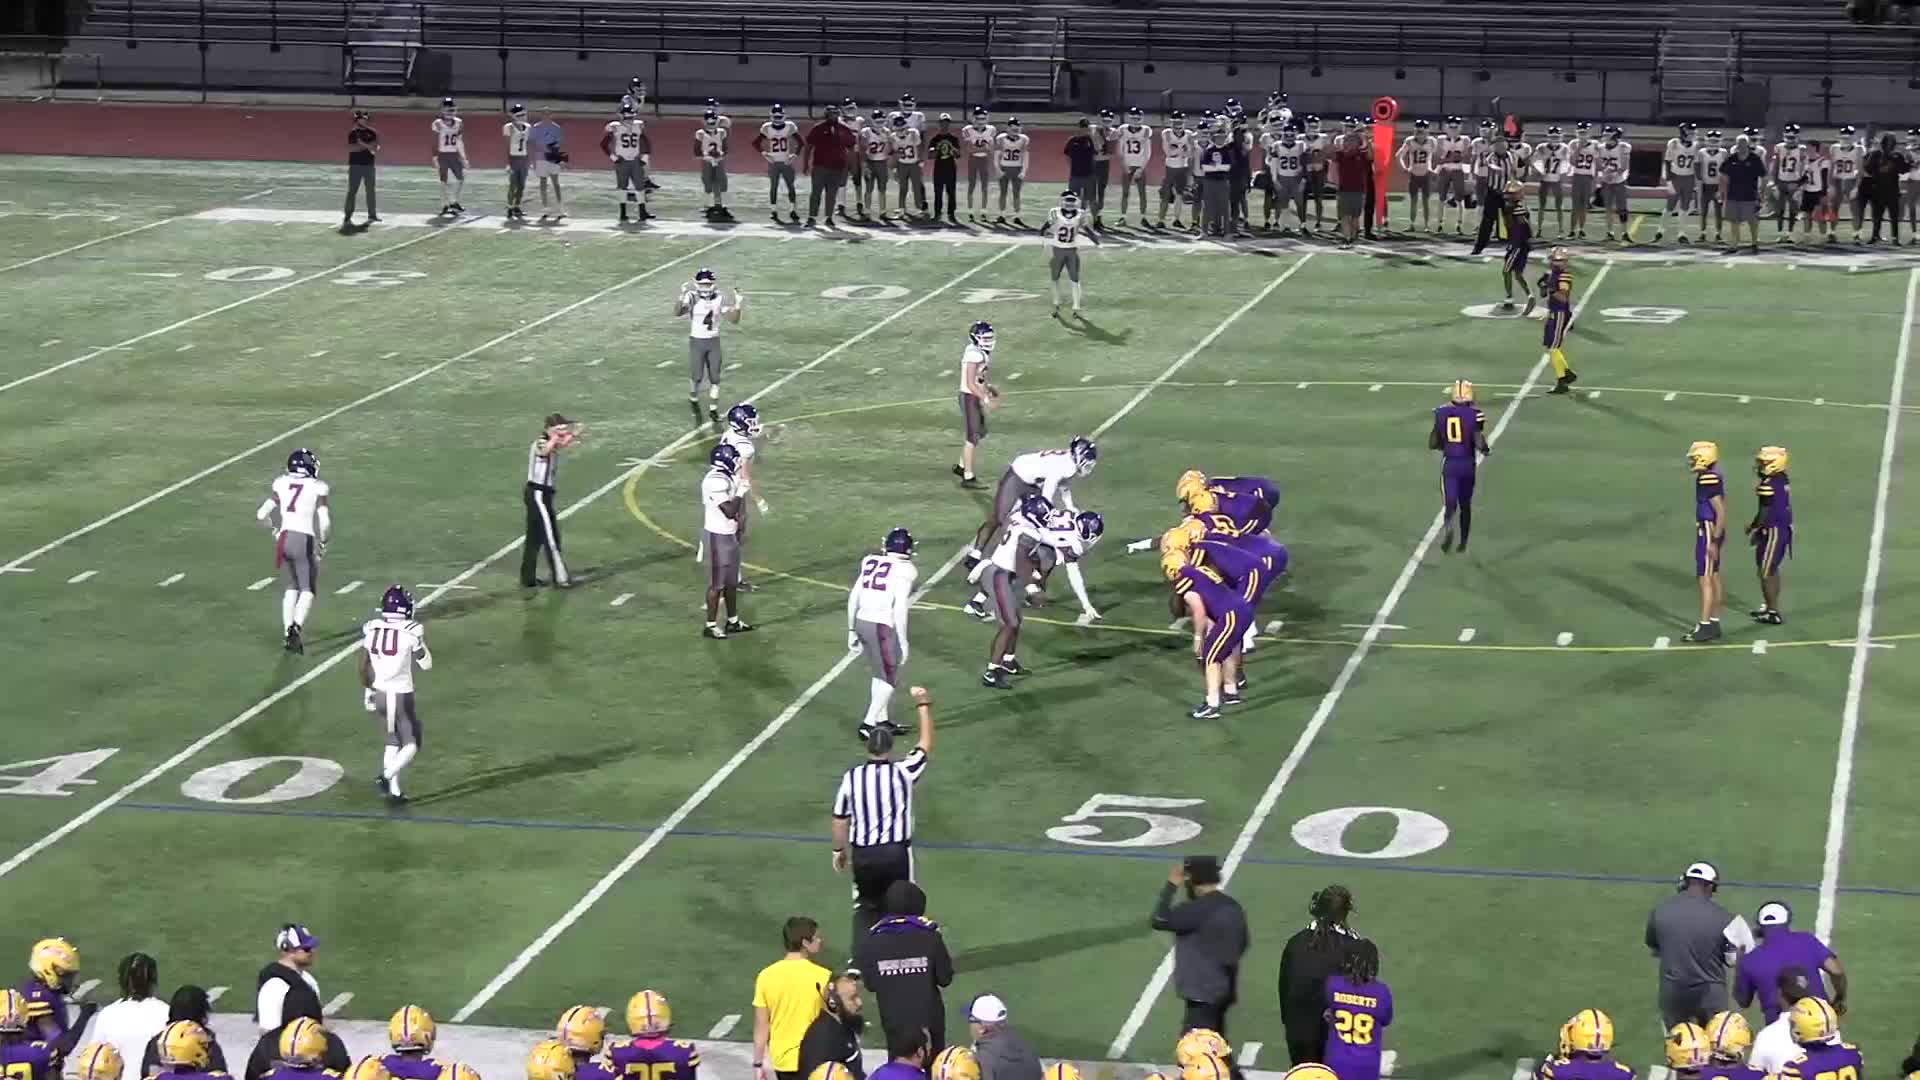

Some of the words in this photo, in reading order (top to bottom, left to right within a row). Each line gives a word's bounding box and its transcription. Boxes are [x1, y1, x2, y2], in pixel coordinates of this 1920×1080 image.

[772, 137, 788, 153] 20
[1126, 140, 1141, 154] 13
[1707, 161, 1717, 177] 6
[1058, 226, 1075, 243] 21
[703, 310, 713, 331] 4
[1446, 416, 1462, 443] 0
[286, 484, 304, 512] 7
[863, 558, 892, 592] 22
[370, 627, 400, 656] 10
[1333, 992, 1377, 1008] ROBERTS
[1335, 1009, 1375, 1045] 28
